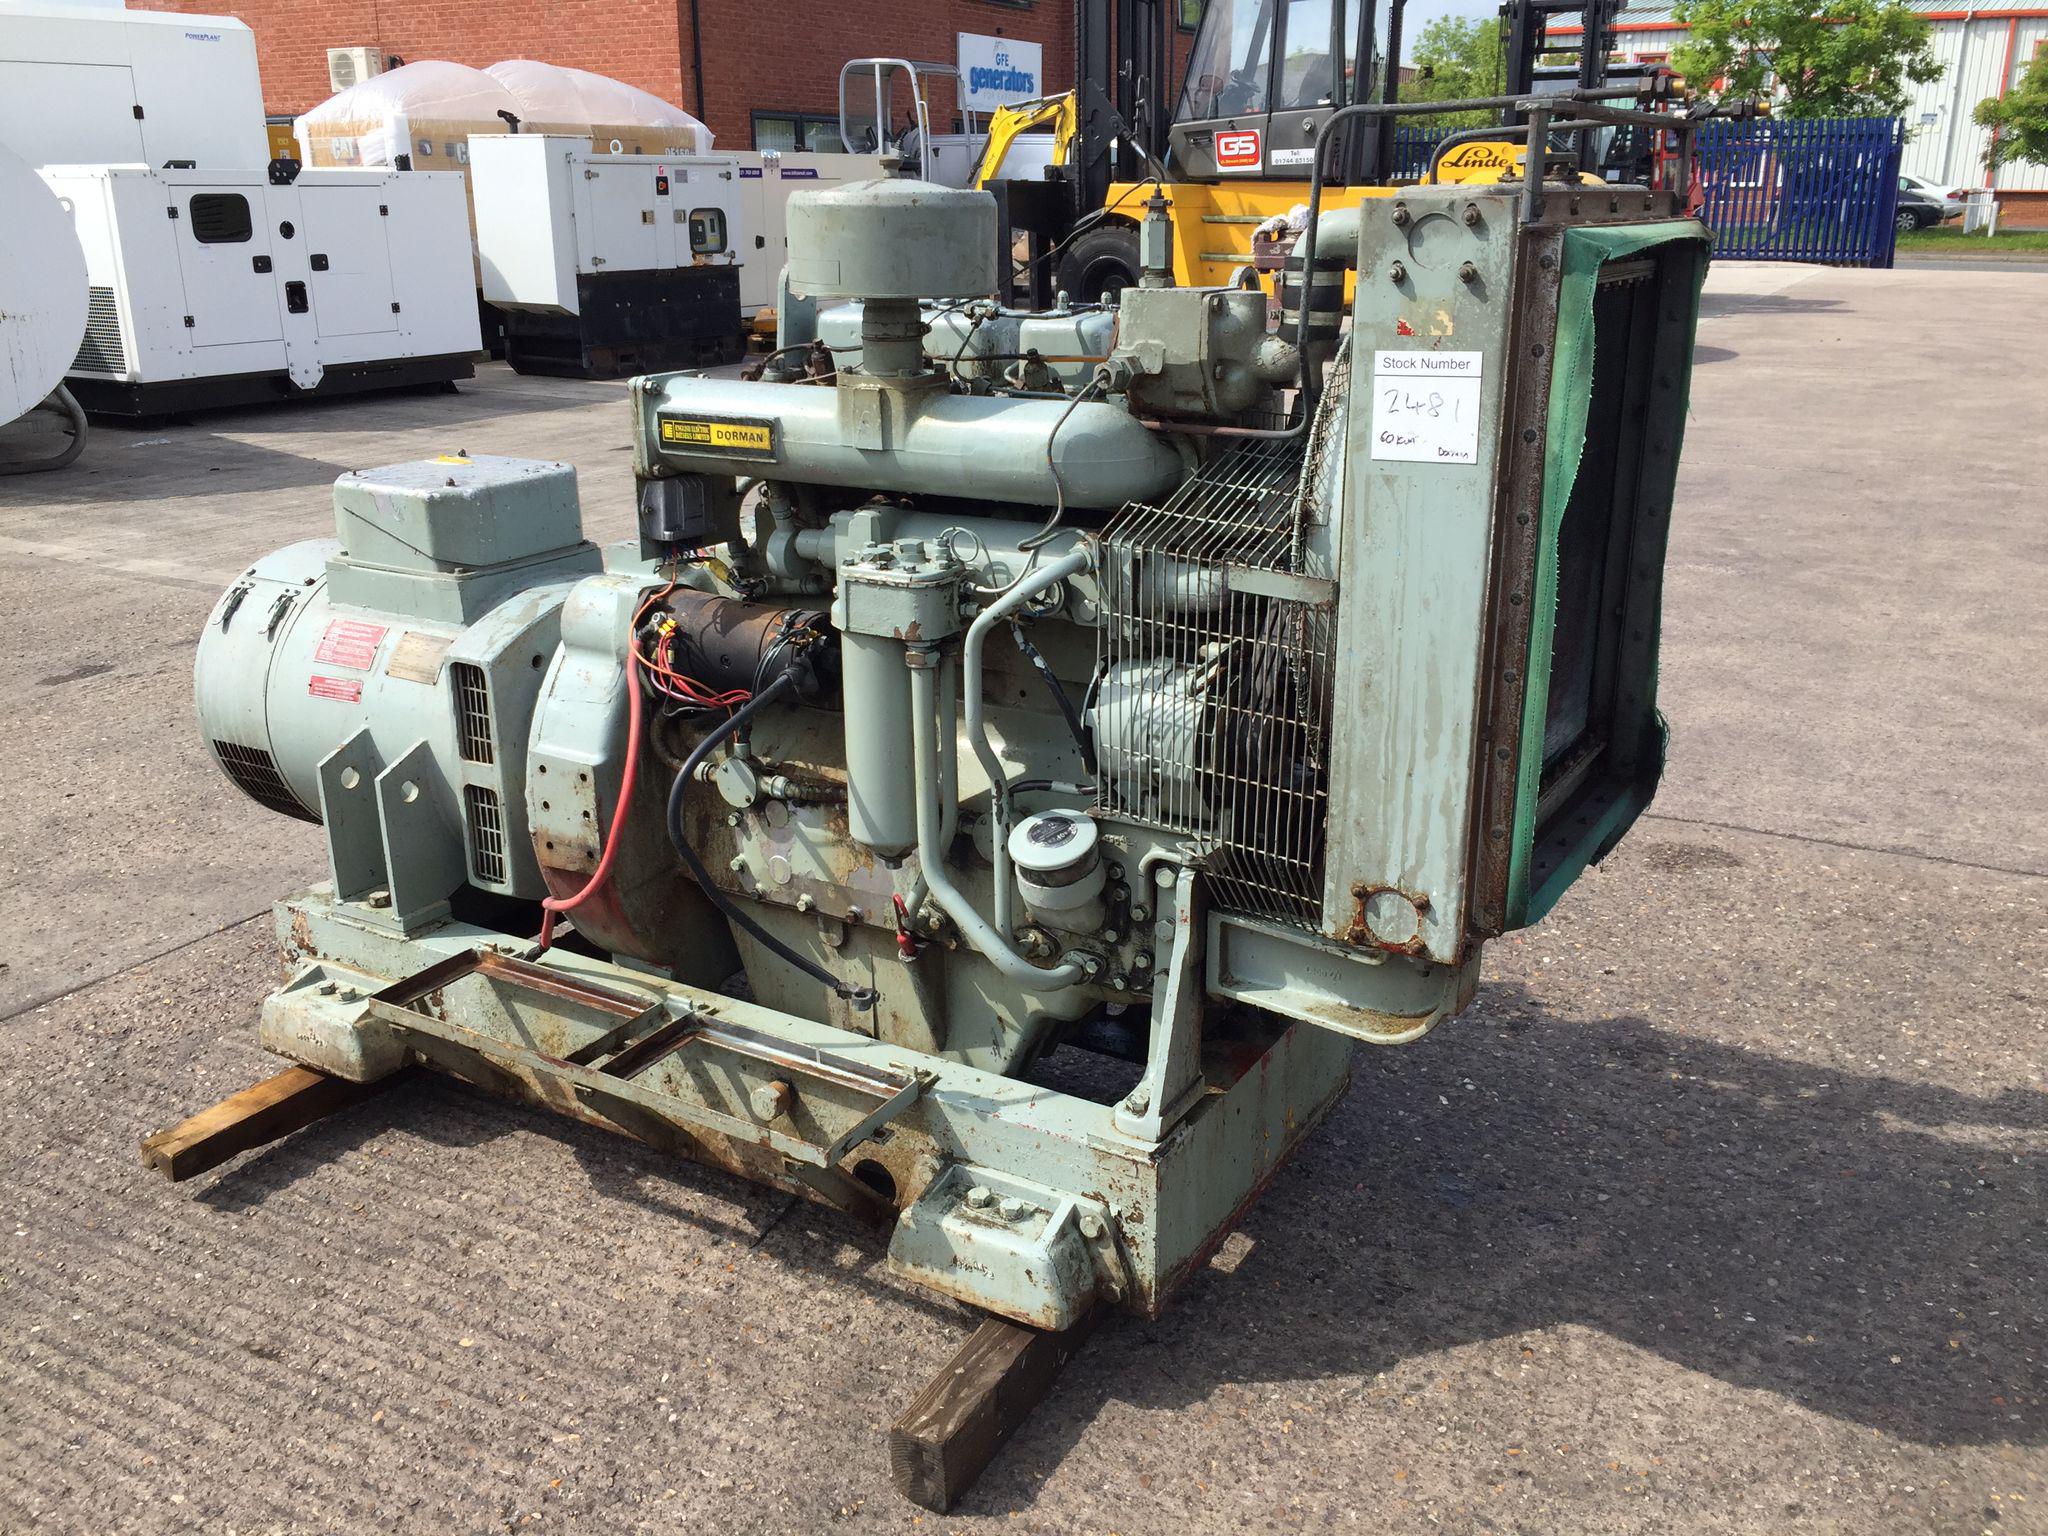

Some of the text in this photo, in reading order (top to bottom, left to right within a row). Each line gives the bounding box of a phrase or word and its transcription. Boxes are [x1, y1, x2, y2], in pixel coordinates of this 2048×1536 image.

[996, 53, 1009, 66] GFE
[970, 66, 1034, 94] generators
[1220, 136, 1256, 156] GS
[1441, 146, 1509, 168] Linde
[1383, 357, 1471, 370] Stock Number
[717, 430, 763, 443] DORMAN
